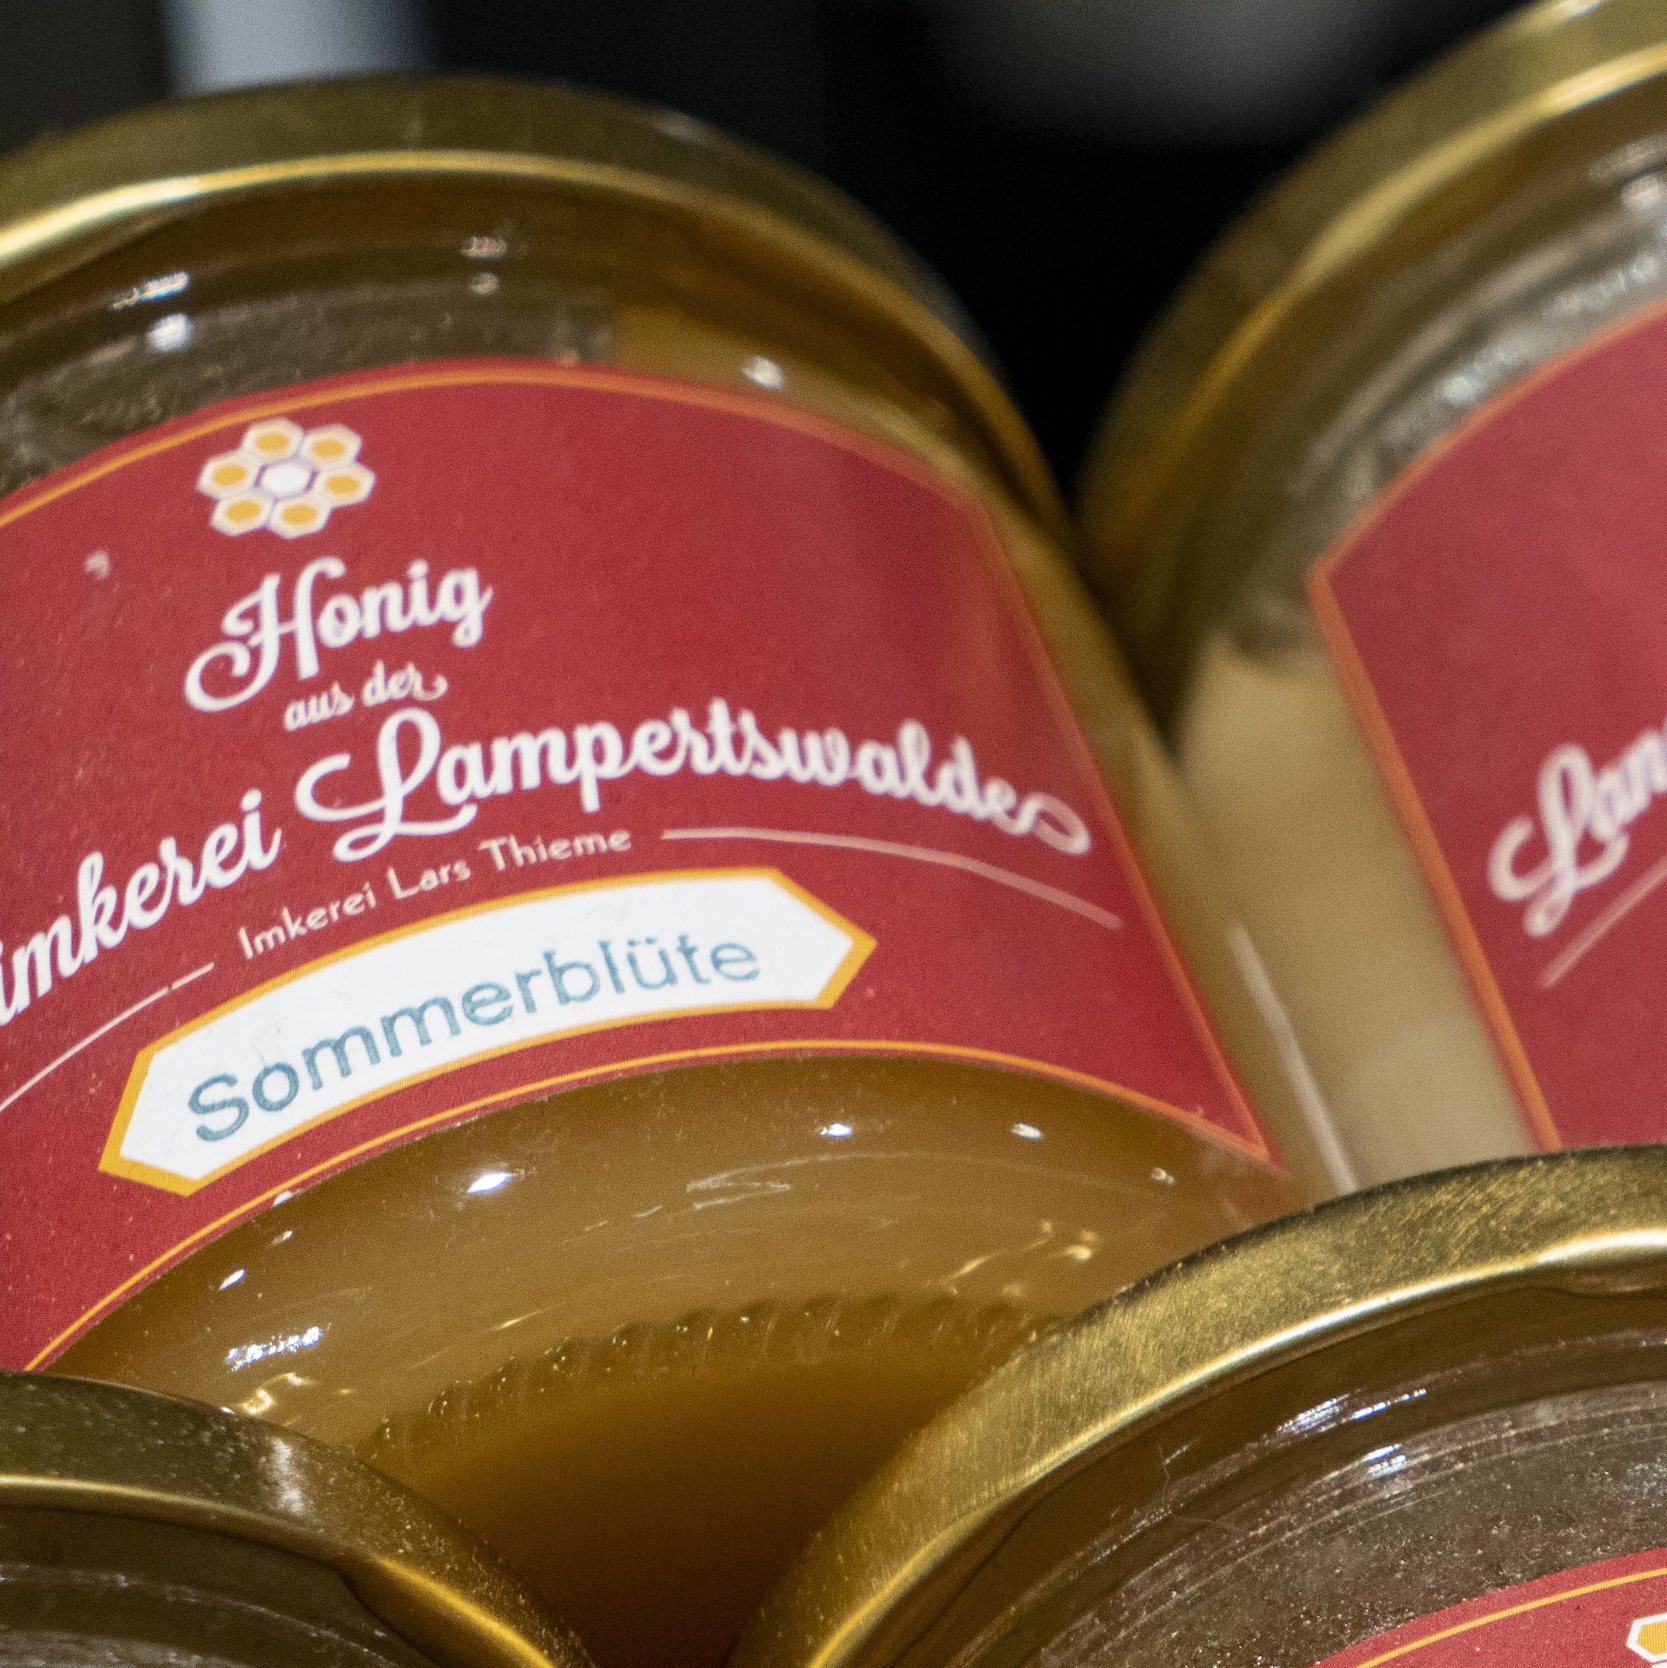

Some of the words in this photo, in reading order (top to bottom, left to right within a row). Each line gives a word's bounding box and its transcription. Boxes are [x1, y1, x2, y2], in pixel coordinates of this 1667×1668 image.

[183, 555, 493, 713] Honig
[284, 677, 356, 734] aus
[360, 660, 448, 713] der
[294, 697, 1092, 863] Lampertswalde
[238, 880, 377, 960] Imkerei
[388, 855, 471, 902] Lars
[479, 823, 633, 871] Thieme
[186, 928, 762, 1147] Sommerblüte
